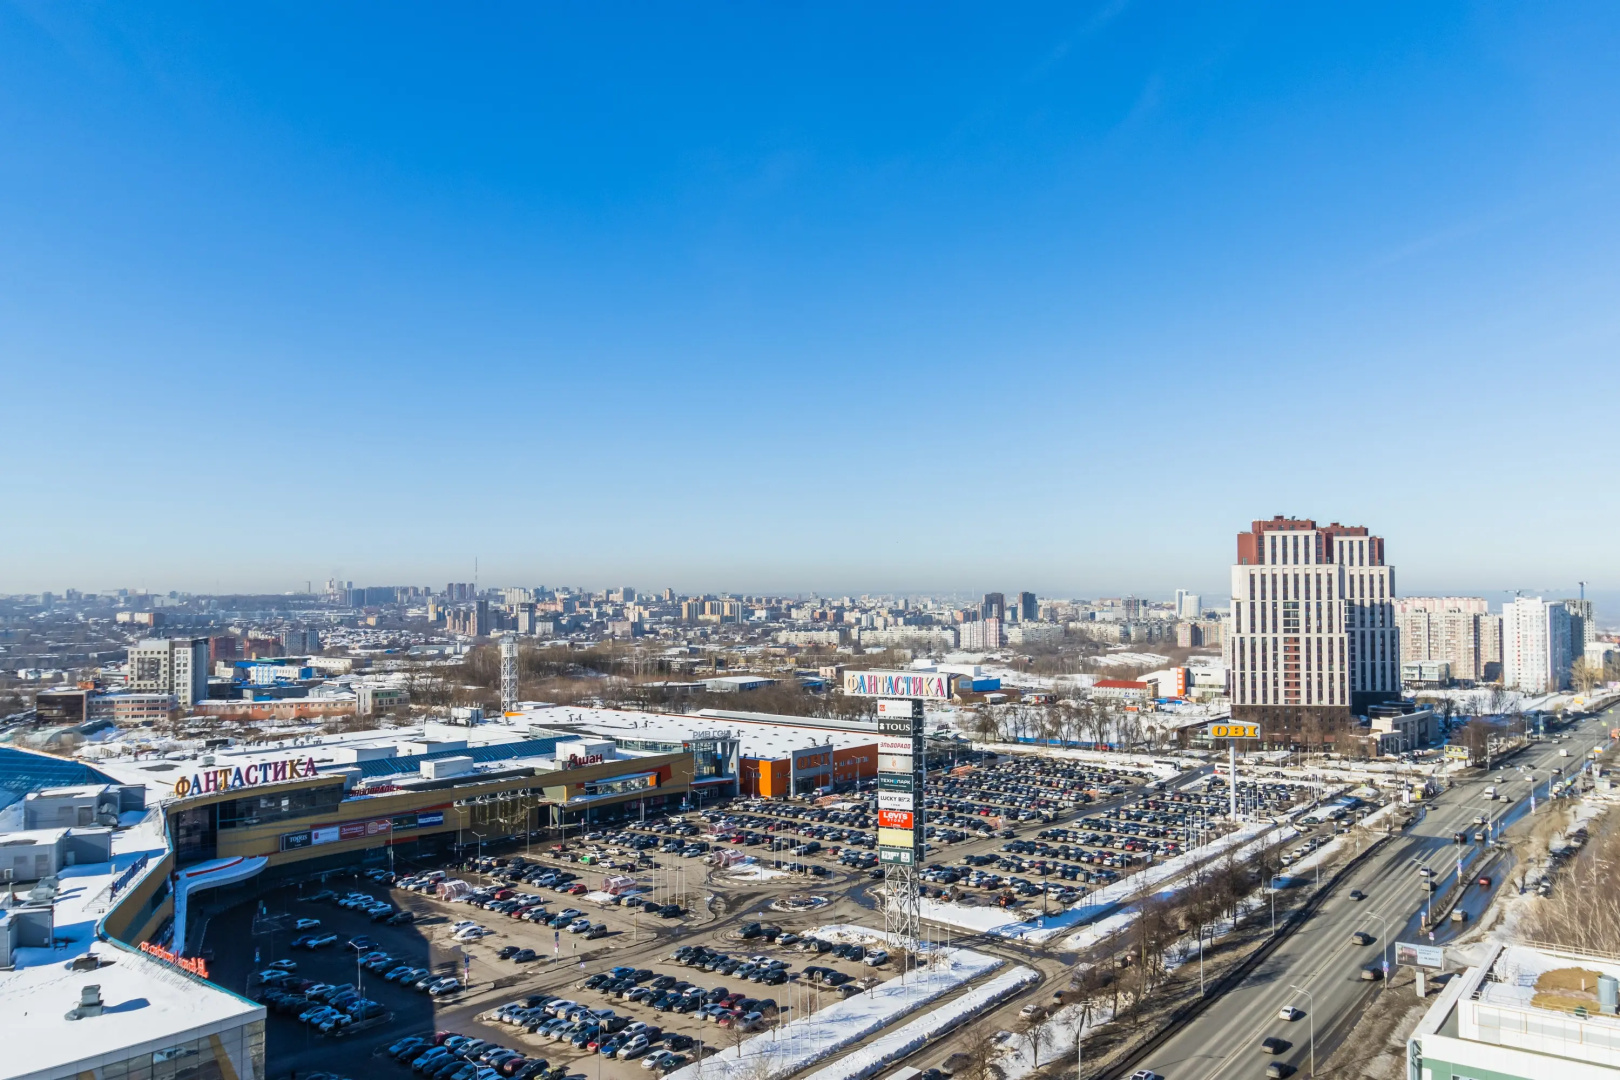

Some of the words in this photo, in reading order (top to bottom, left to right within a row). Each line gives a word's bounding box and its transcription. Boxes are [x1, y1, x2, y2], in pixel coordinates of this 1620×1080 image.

[848, 674, 946, 697] ФАНТАСТИКА
[886, 723, 911, 732] TOUS
[1211, 725, 1258, 738] OBI
[567, 753, 603, 770] Ашан
[174, 757, 319, 799] ФАНТАСТИКА
